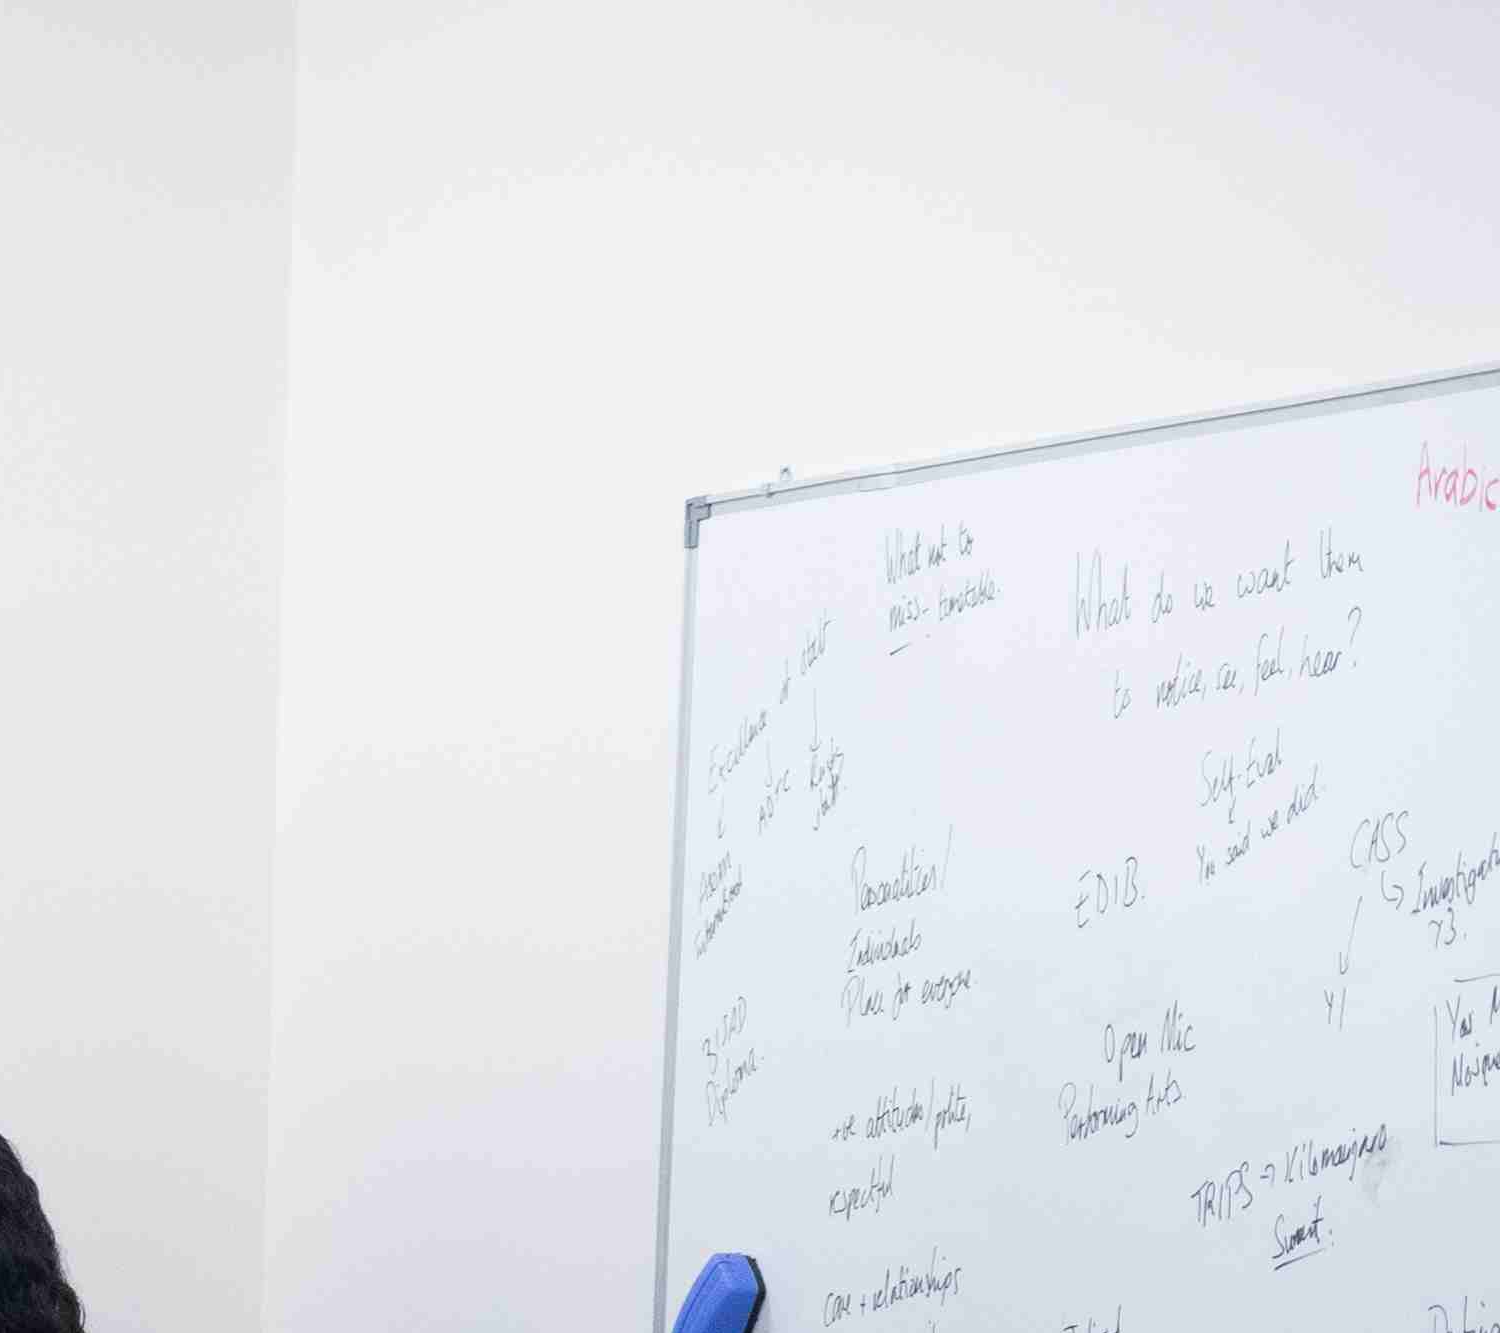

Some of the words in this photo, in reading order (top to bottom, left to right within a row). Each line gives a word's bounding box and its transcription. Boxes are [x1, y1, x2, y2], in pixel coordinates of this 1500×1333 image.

[1415, 440, 1500, 511] Arabic
[1075, 546, 1132, 640] What
[1150, 567, 1174, 623] do
[1193, 581, 1216, 611] we
[1236, 538, 1296, 599] want
[1318, 525, 1364, 579] them
[1113, 669, 1132, 719] to
[1104, 1023, 1148, 1082] Open
[1160, 1000, 1197, 1054] Mic
[1191, 1160, 1253, 1228] TRIPS
